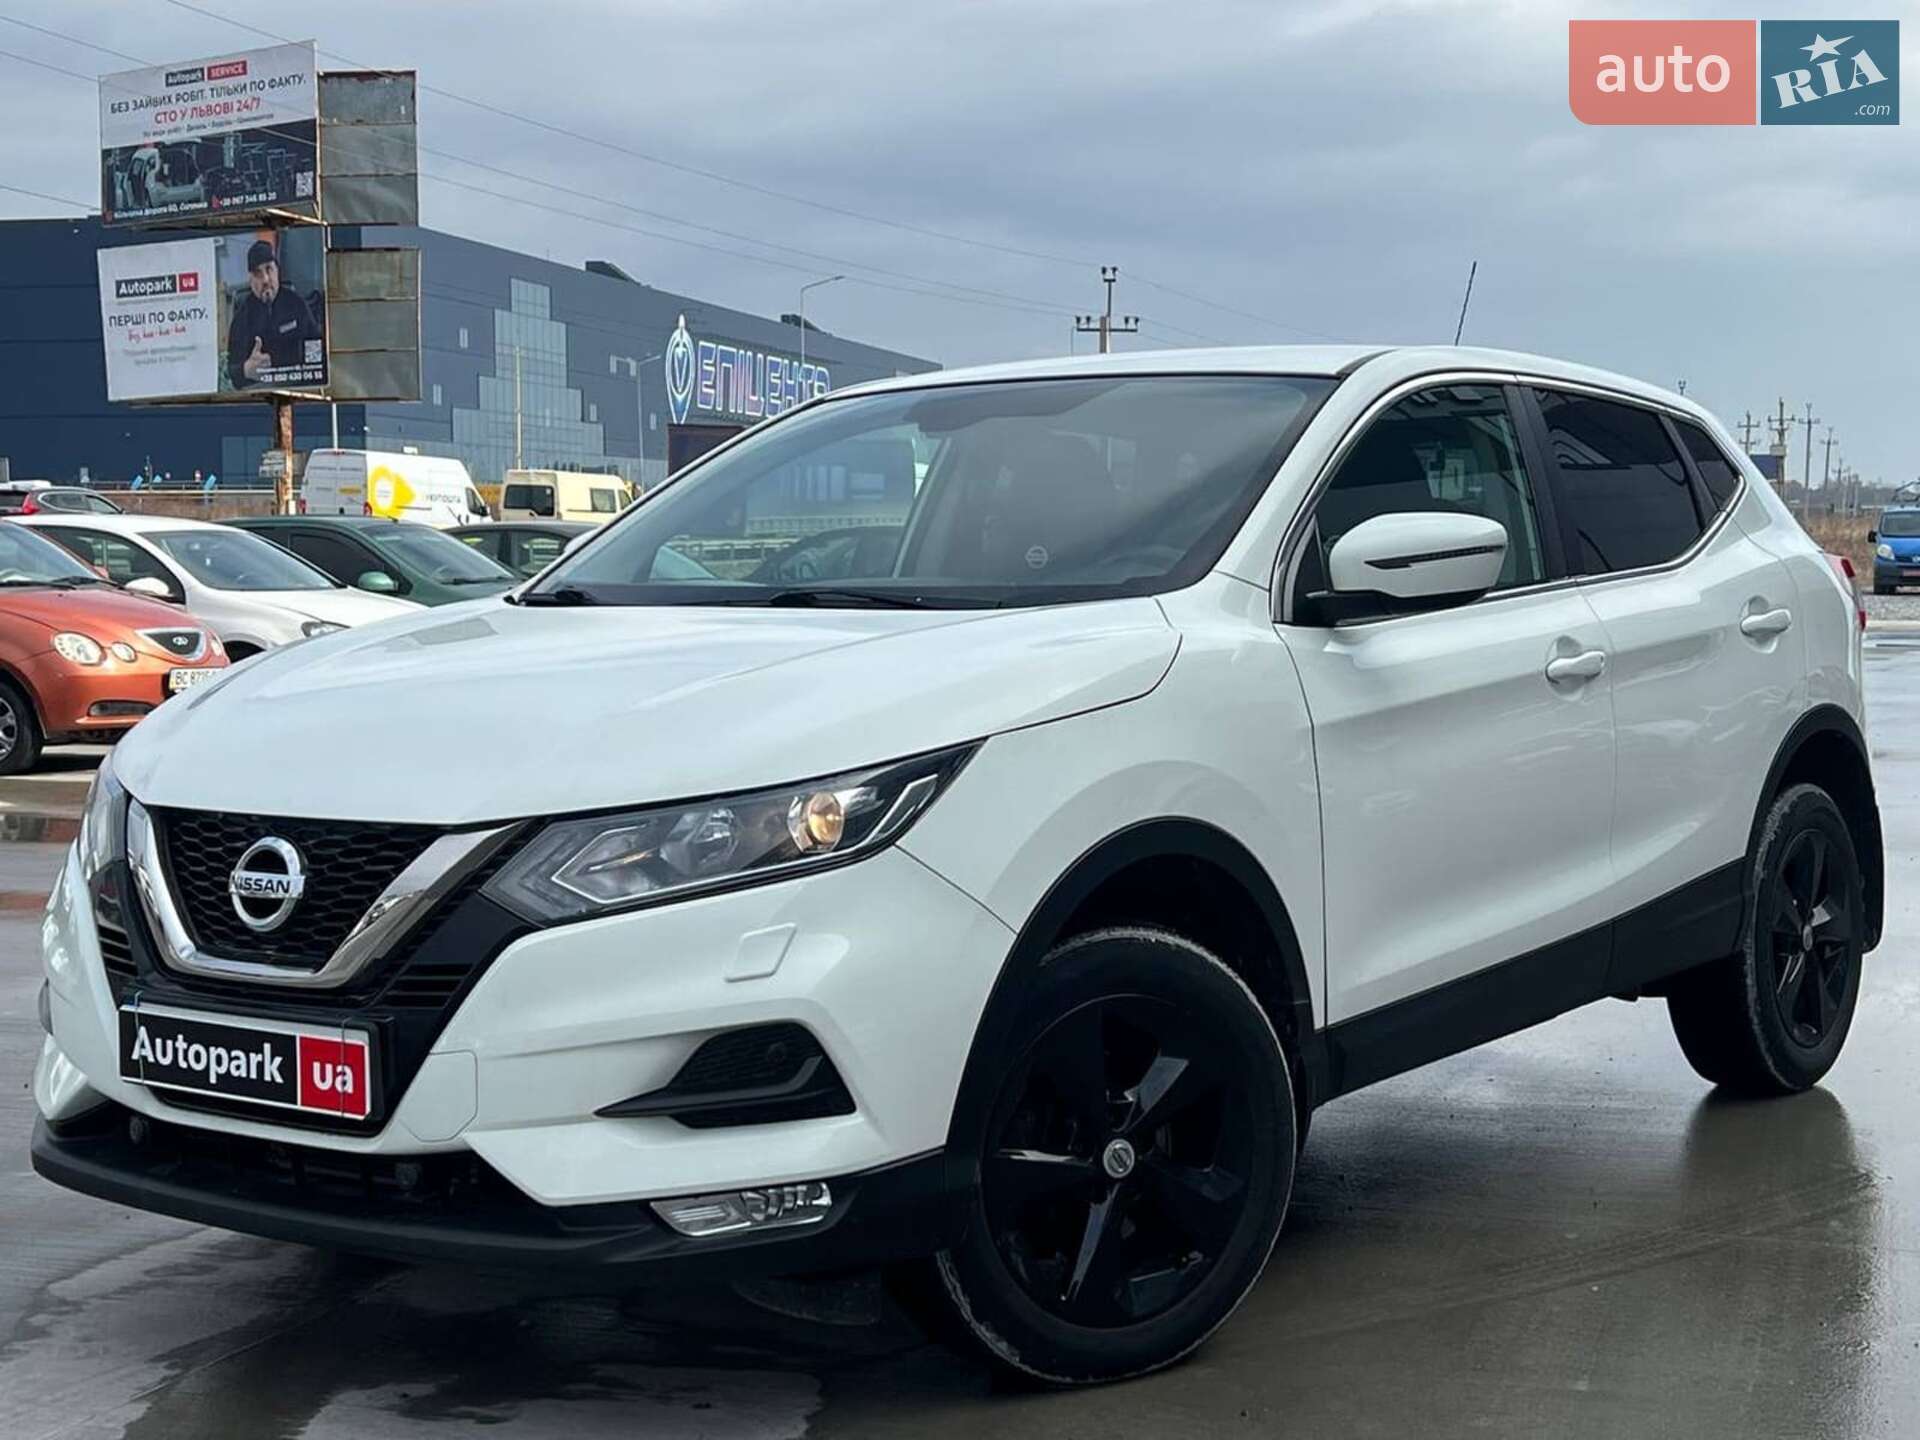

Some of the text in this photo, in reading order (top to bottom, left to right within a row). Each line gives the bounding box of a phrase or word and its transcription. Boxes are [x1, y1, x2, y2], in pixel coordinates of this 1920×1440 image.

[210, 63, 245, 78] SERVICE
[110, 102, 130, 114] БЕЗ
[133, 95, 173, 111] ЗАЙВИХ
[210, 83, 247, 100] ТІЛЬКИ
[250, 80, 266, 93] ПО
[155, 98, 261, 125] СТО У ЛЬВОВІ 24/7
[119, 277, 195, 295] Autopark ua
[109, 313, 146, 327] ПЕРШІ
[149, 312, 165, 323] ПО
[230, 874, 290, 894] NISSAN
[132, 1025, 354, 1094] Autopark ua
